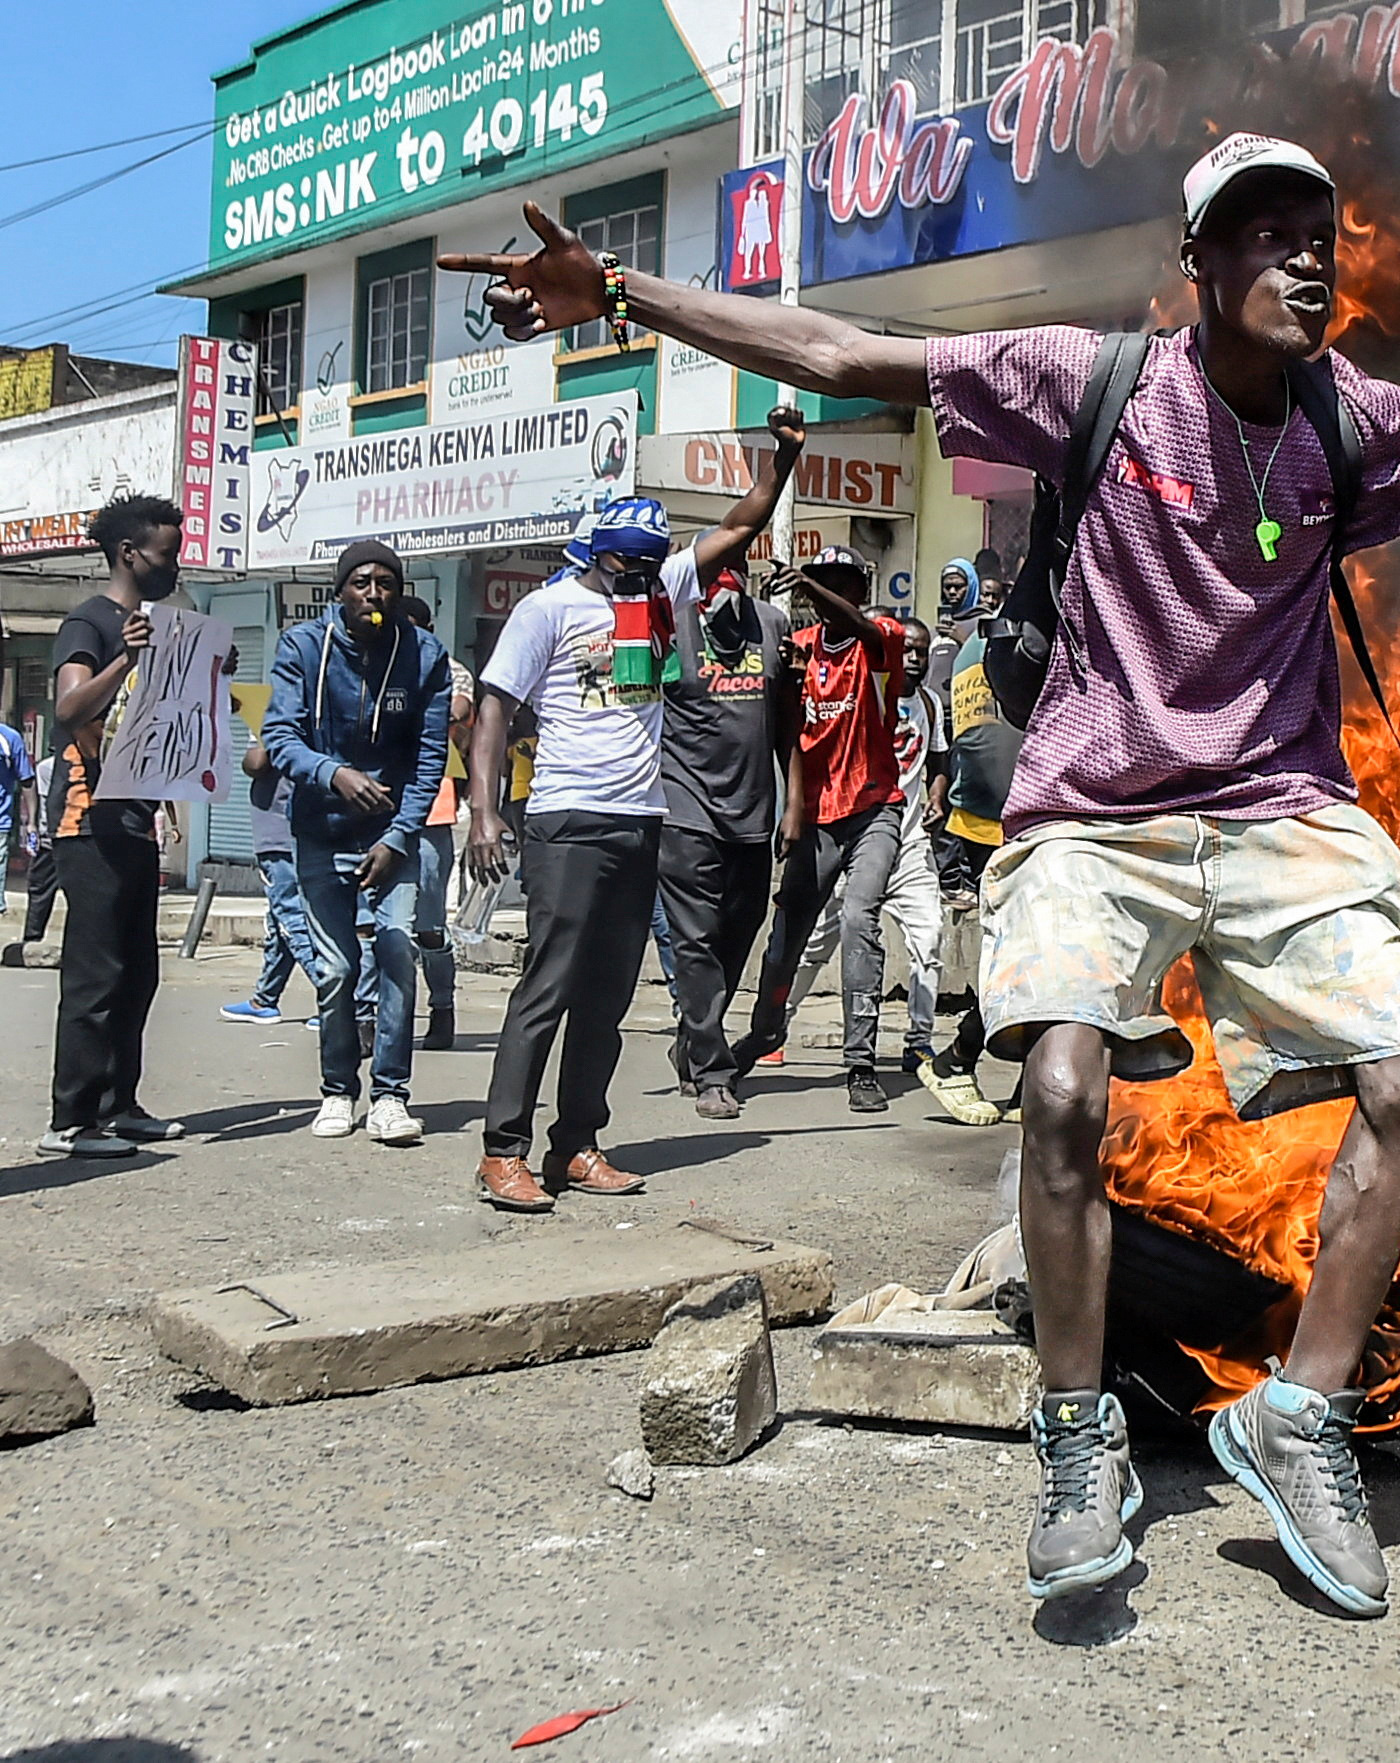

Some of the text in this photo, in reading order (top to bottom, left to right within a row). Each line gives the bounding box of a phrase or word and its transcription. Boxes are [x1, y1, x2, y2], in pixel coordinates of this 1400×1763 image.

[226, 105, 261, 147] Get
[265, 107, 277, 134] a
[280, 72, 341, 127] Quick
[348, 31, 446, 101] Logbook
[451, 13, 497, 61] Loan
[502, 0, 525, 36] in
[247, 147, 270, 179] CRB
[271, 134, 315, 171] Checks
[322, 117, 350, 150] Get
[352, 115, 371, 143] up
[374, 105, 390, 133] to
[389, 96, 402, 124] 4
[404, 84, 450, 120] Million
[497, 45, 525, 81] 24
[530, 26, 601, 73] Months
[396, 125, 446, 194] to
[807, 78, 974, 224] Wa
[449, 365, 510, 398] CREDIT
[457, 344, 505, 374] NGAO
[308, 408, 341, 427] CREDIT
[313, 396, 339, 414] NGAO
[183, 340, 214, 561] TRANSMEGA
[217, 342, 253, 569] CHEMIST
[314, 407, 589, 483] TRANSMEGA KENYA LIMITED
[355, 468, 520, 526] PHARMACY
[1, 536, 76, 555] WHOLESALE
[31, 512, 82, 537] WEAR
[397, 528, 465, 550] Wholesalers
[468, 525, 491, 543] and
[494, 519, 571, 540] Distributors
[698, 664, 766, 693] Tacos
